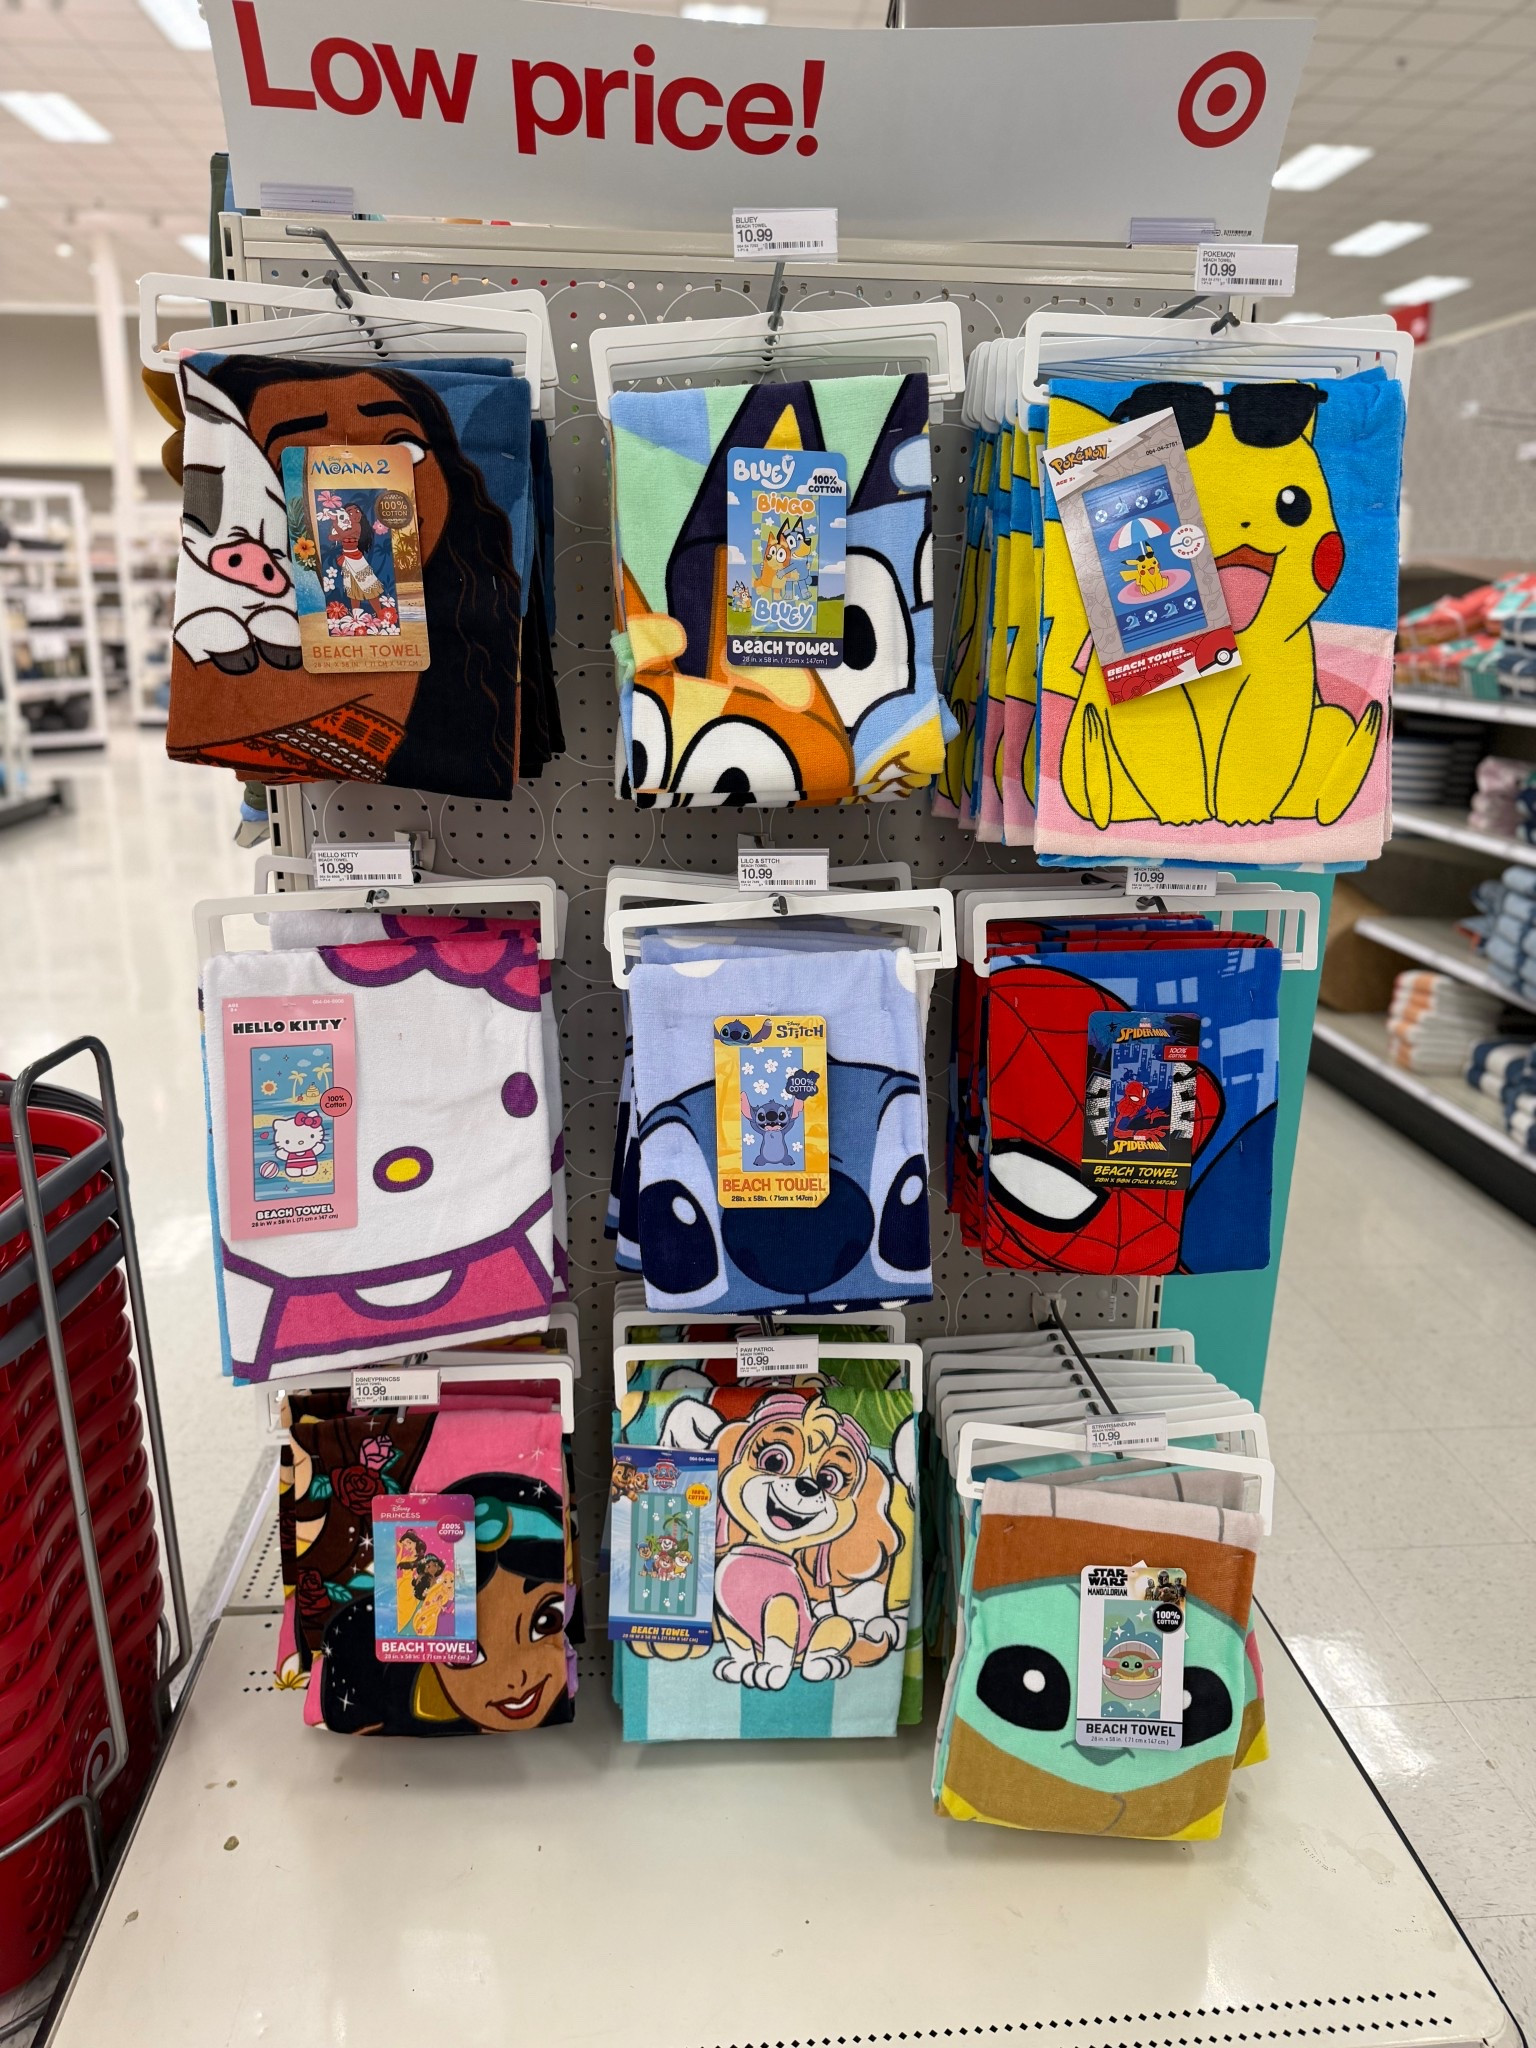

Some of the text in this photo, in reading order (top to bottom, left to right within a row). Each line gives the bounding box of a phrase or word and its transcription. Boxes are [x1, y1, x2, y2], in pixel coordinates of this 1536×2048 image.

[231, 0, 826, 157] Low price!
[735, 216, 758, 224] BLUEY
[737, 228, 773, 242] 10.99
[1203, 250, 1236, 258] POKEMON
[1203, 263, 1237, 277] 10.99
[376, 459, 391, 475] 2
[733, 454, 796, 490] BLUEY
[812, 474, 838, 485] 100%
[808, 485, 843, 494] COTTON
[380, 501, 408, 510] 100%
[1178, 542, 1201, 556] COTTON
[312, 644, 422, 659] BEACH TOWEL
[1107, 660, 1146, 678] BEACH
[1147, 646, 1186, 664] TOWEL
[319, 862, 354, 874] 10.99
[741, 868, 773, 879] 10.99
[1133, 872, 1165, 883] 10.99
[232, 1018, 342, 1035] HELLO KITTY
[790, 1078, 814, 1086] 100%
[788, 1085, 817, 1093] COTTON
[325, 1101, 347, 1109] Cotton
[1093, 1165, 1179, 1178] BEACH TOWEL
[722, 1177, 826, 1192] BEACH TOWEL
[256, 1203, 334, 1221] BEACH TOWEL
[741, 1356, 769, 1366] 10.99
[356, 1386, 387, 1396] 10.99
[1093, 1431, 1120, 1442] 10.99
[1088, 1568, 1128, 1578] STAR
[1088, 1577, 1128, 1587] WARS
[1087, 1587, 1128, 1597] MANDALORIAN
[1155, 1610, 1181, 1620] 100%
[631, 1626, 659, 1635] BEACH
[661, 1627, 690, 1637] TOWEL
[381, 1642, 473, 1653] BEACH TOWEL
[1086, 1723, 1176, 1738] BEACH TOWEL
